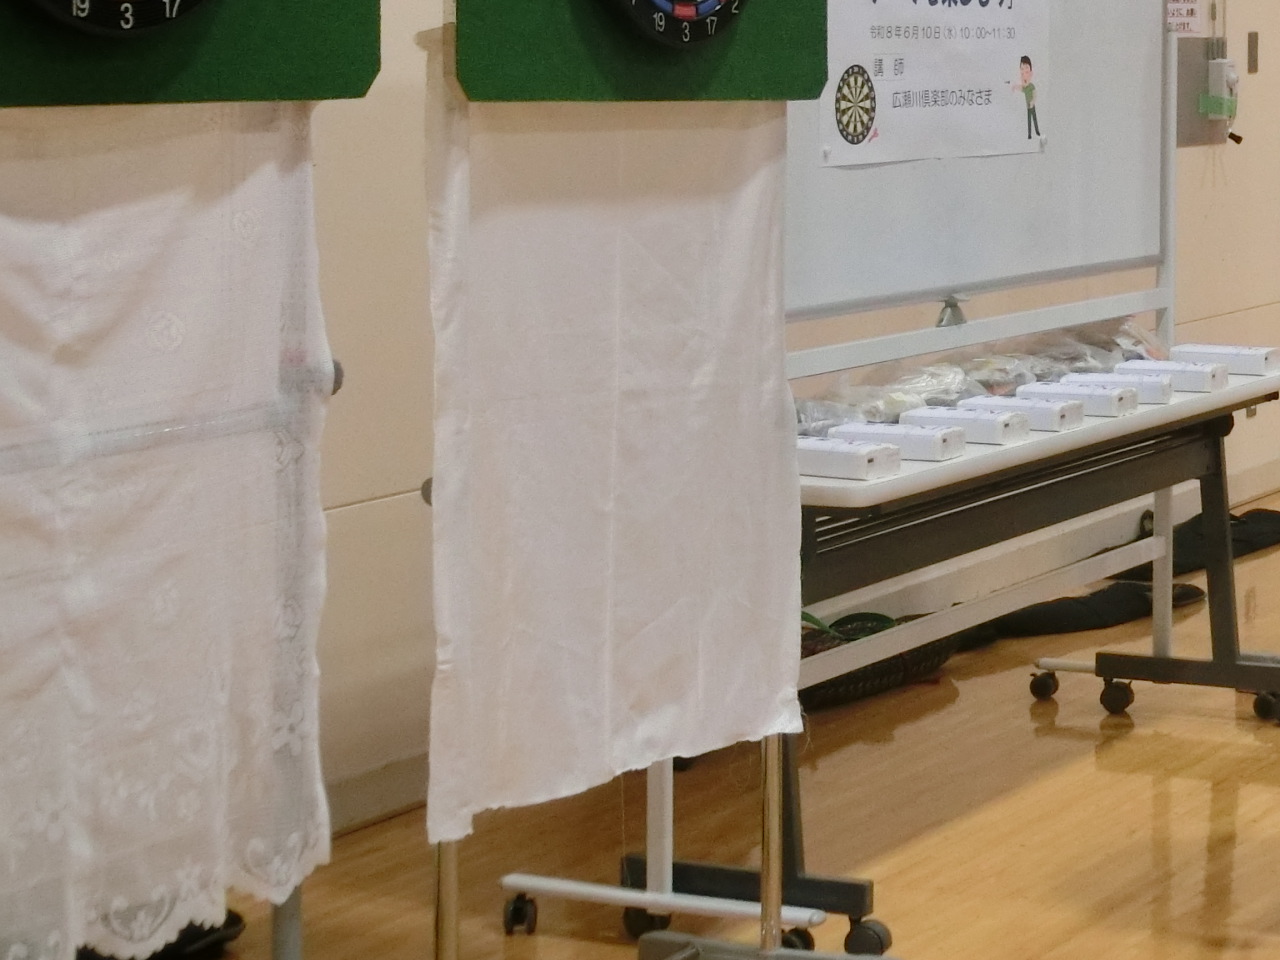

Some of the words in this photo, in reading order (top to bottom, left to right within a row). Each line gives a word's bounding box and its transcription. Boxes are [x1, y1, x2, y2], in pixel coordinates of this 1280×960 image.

[121, 3, 132, 28] 3
[653, 12, 665, 32] 19
[706, 16, 717, 35] 17
[682, 21, 690, 42] 3
